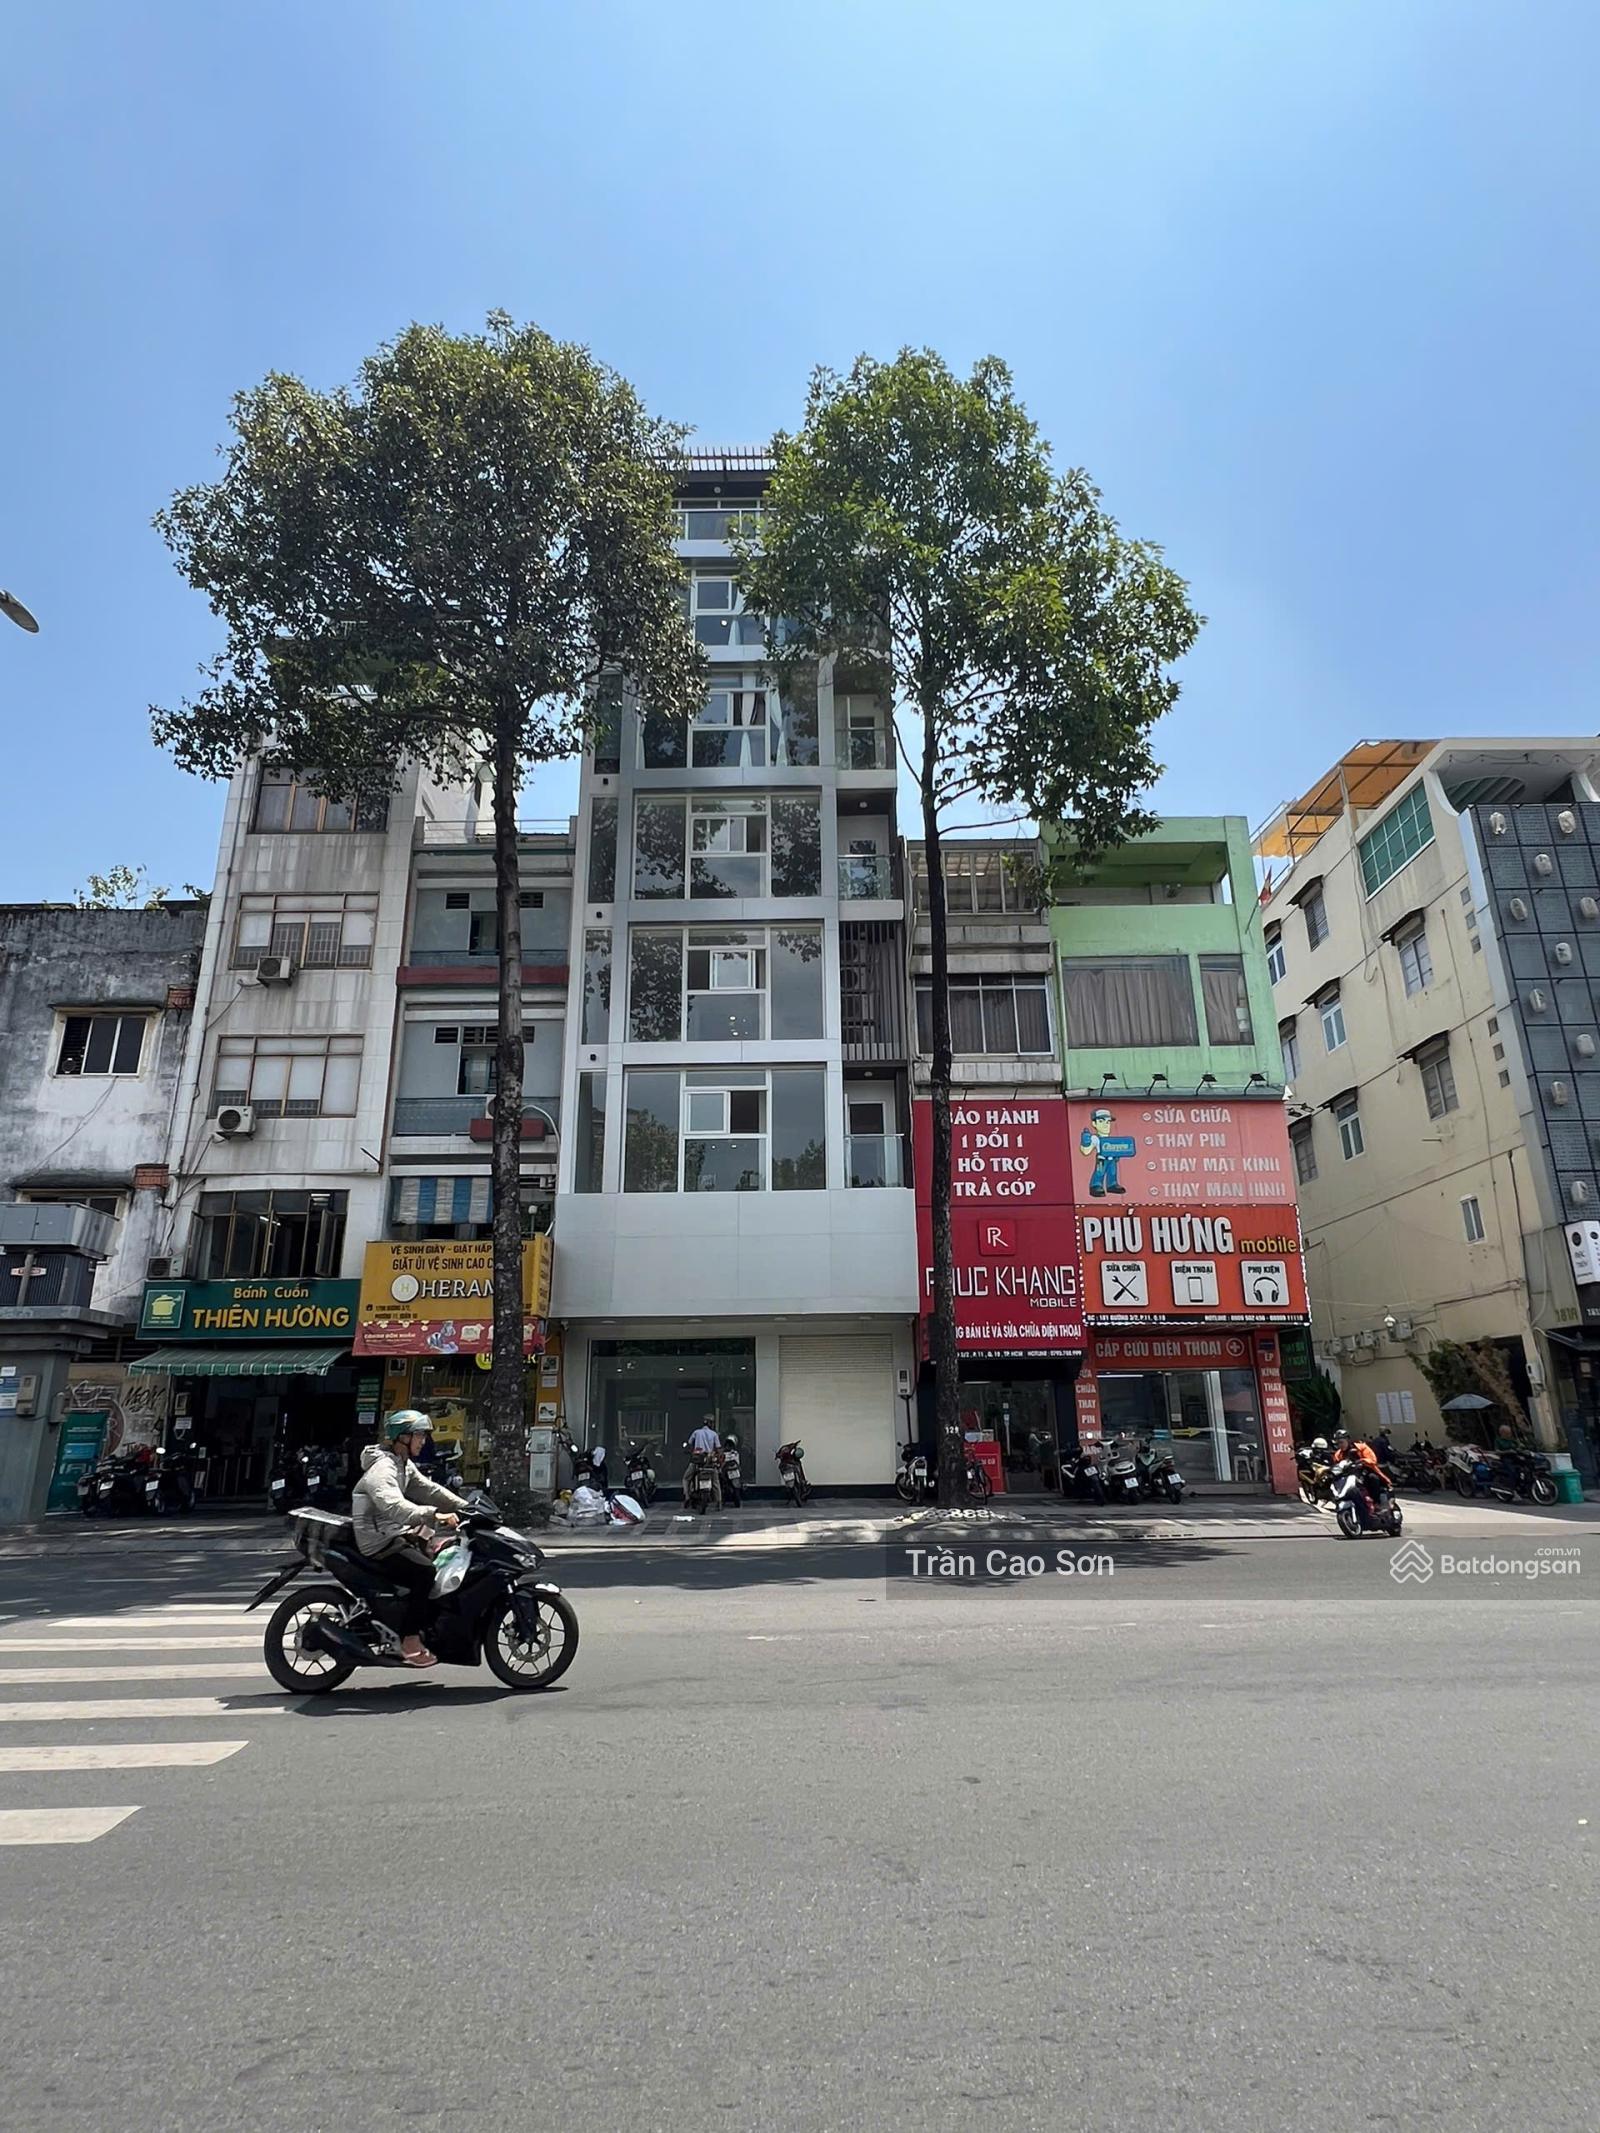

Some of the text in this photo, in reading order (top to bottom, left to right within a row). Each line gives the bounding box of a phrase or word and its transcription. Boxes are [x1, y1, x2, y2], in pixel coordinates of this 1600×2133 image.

[986, 1107, 1039, 1124] HÀNH
[1154, 1104, 1231, 1124] SỬA CHỮA
[962, 1127, 1023, 1148] 1 ĐỔI 1
[1156, 1132, 1226, 1148] THAY PIN
[958, 1152, 1029, 1175] HỖ TRỢ
[1160, 1157, 1196, 1172] THAY
[1203, 1154, 1236, 1175] MẶT
[953, 1177, 1036, 1196] TRẢ GÓP
[1162, 1182, 1200, 1198] THAY
[1082, 1208, 1234, 1253] PHÚ HƯNG
[404, 1245, 424, 1254] SINH
[1240, 1236, 1297, 1253] mobile
[428, 1256, 440, 1271] VỆ
[442, 1258, 464, 1270] SINH
[466, 1258, 484, 1269] CAO
[1105, 1262, 1141, 1272] SỬA CHỮA
[1247, 1264, 1281, 1275] PHỤ KIỆN
[995, 1265, 1077, 1296] KHANG
[233, 1283, 309, 1299] Bánh Cuốn
[1030, 1298, 1077, 1308] MOBILE
[192, 1303, 349, 1329] THIÊN HƯƠNG
[965, 1322, 982, 1339] BÁN
[982, 1321, 991, 1338] LẺ
[992, 1321, 1003, 1338] VÀ
[1003, 1320, 1019, 1338] SỬA
[1019, 1320, 1041, 1338] CHỮA
[1041, 1322, 1058, 1340] ĐIỆN
[1059, 1324, 1081, 1340] THOẠI
[1095, 1338, 1119, 1357] CẤP
[1184, 1340, 1222, 1358] THOẠI
[1263, 1382, 1282, 1392] THAY
[1078, 1399, 1097, 1409] THAY
[1081, 1414, 1096, 1424] PIN
